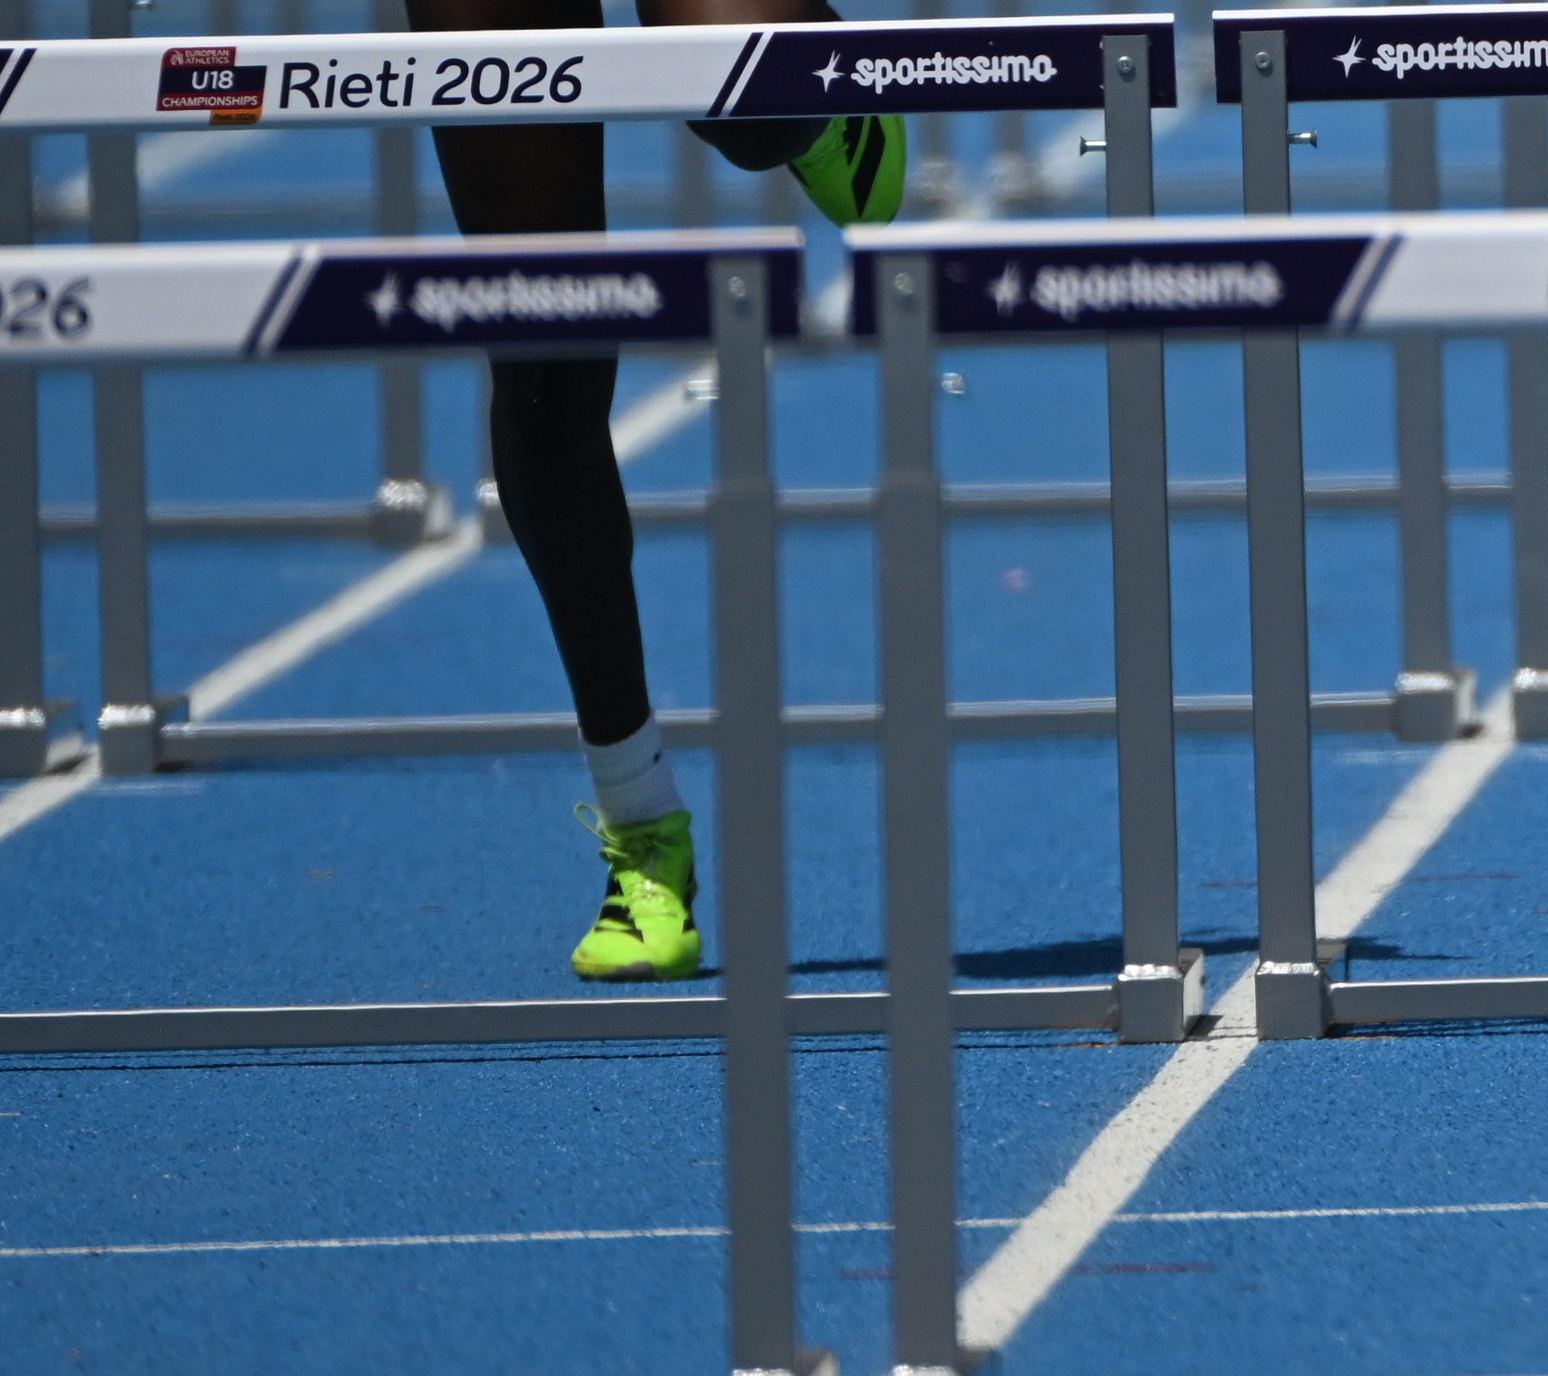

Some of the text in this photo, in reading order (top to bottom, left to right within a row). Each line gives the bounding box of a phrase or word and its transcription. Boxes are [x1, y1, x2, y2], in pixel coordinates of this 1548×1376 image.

[191, 70, 234, 90] U18
[279, 55, 585, 109] Rieti 2026
[850, 51, 1057, 94] sportissimo
[161, 96, 258, 108] CHAMPIONSHIPS
[409, 271, 662, 331] sportissimo
[1031, 259, 1281, 316] sportissimo
